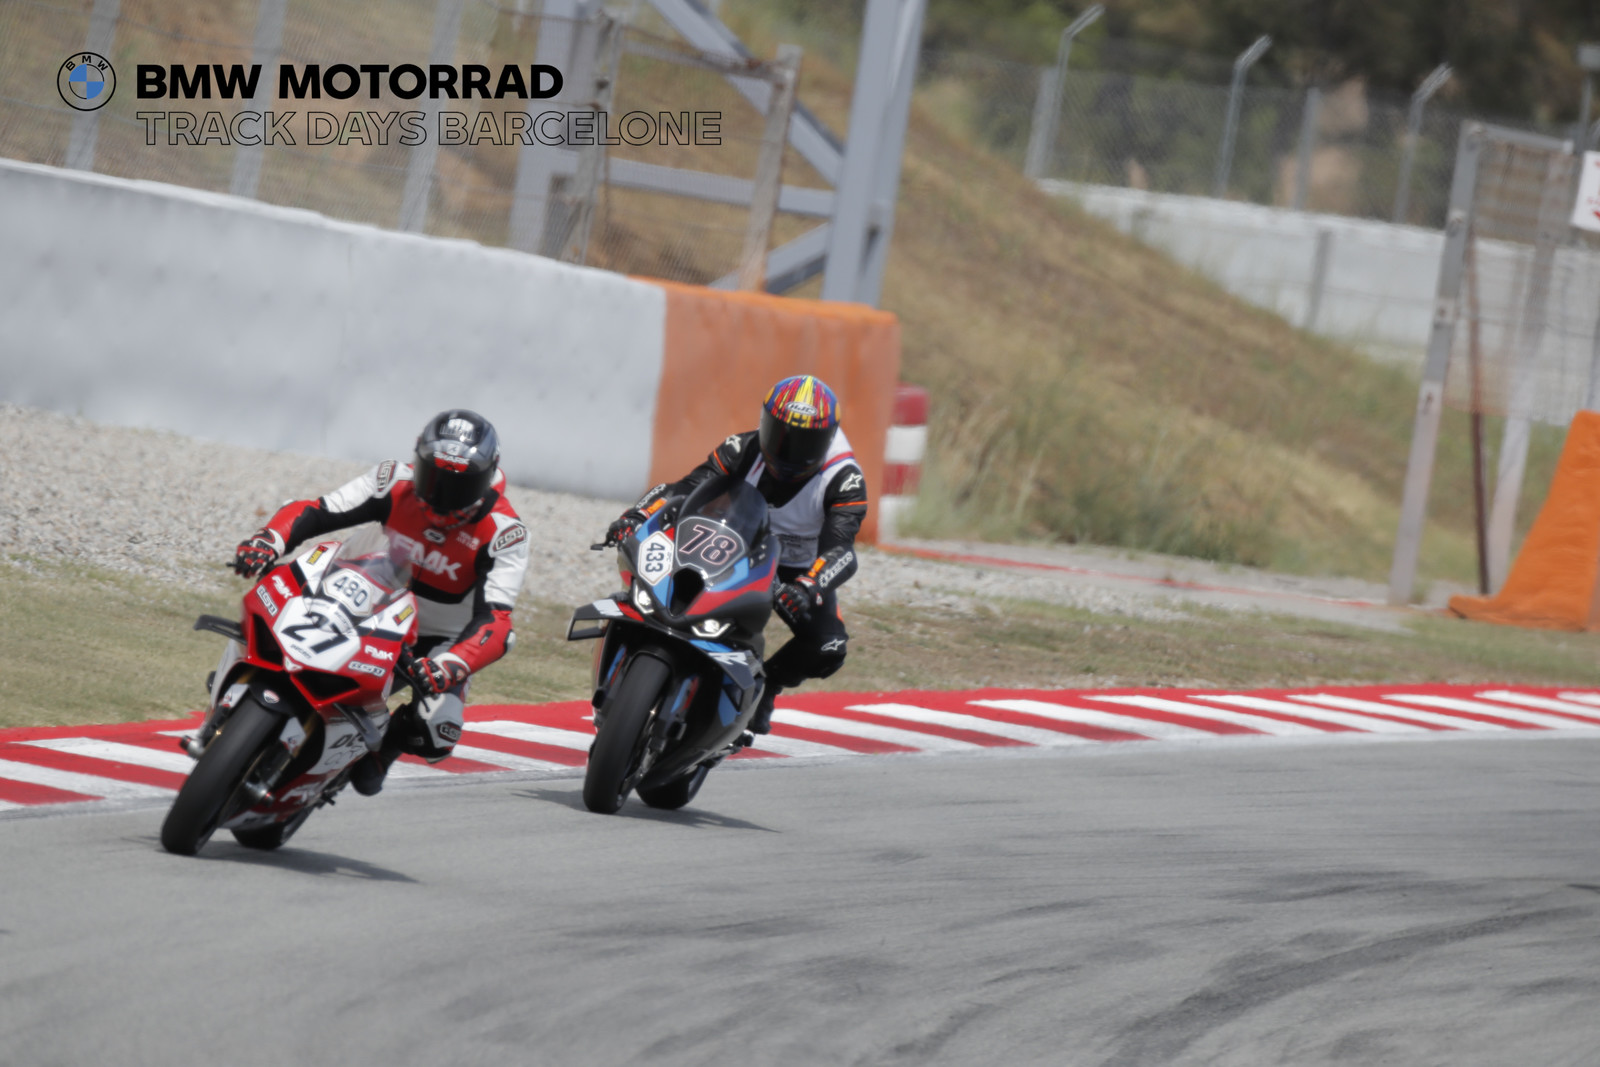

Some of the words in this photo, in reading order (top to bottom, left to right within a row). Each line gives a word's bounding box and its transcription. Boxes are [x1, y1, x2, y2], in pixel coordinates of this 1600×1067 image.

[645, 542, 666, 573] 433
[679, 524, 737, 565] 78
[333, 576, 368, 607] 480
[281, 611, 350, 654] 27
